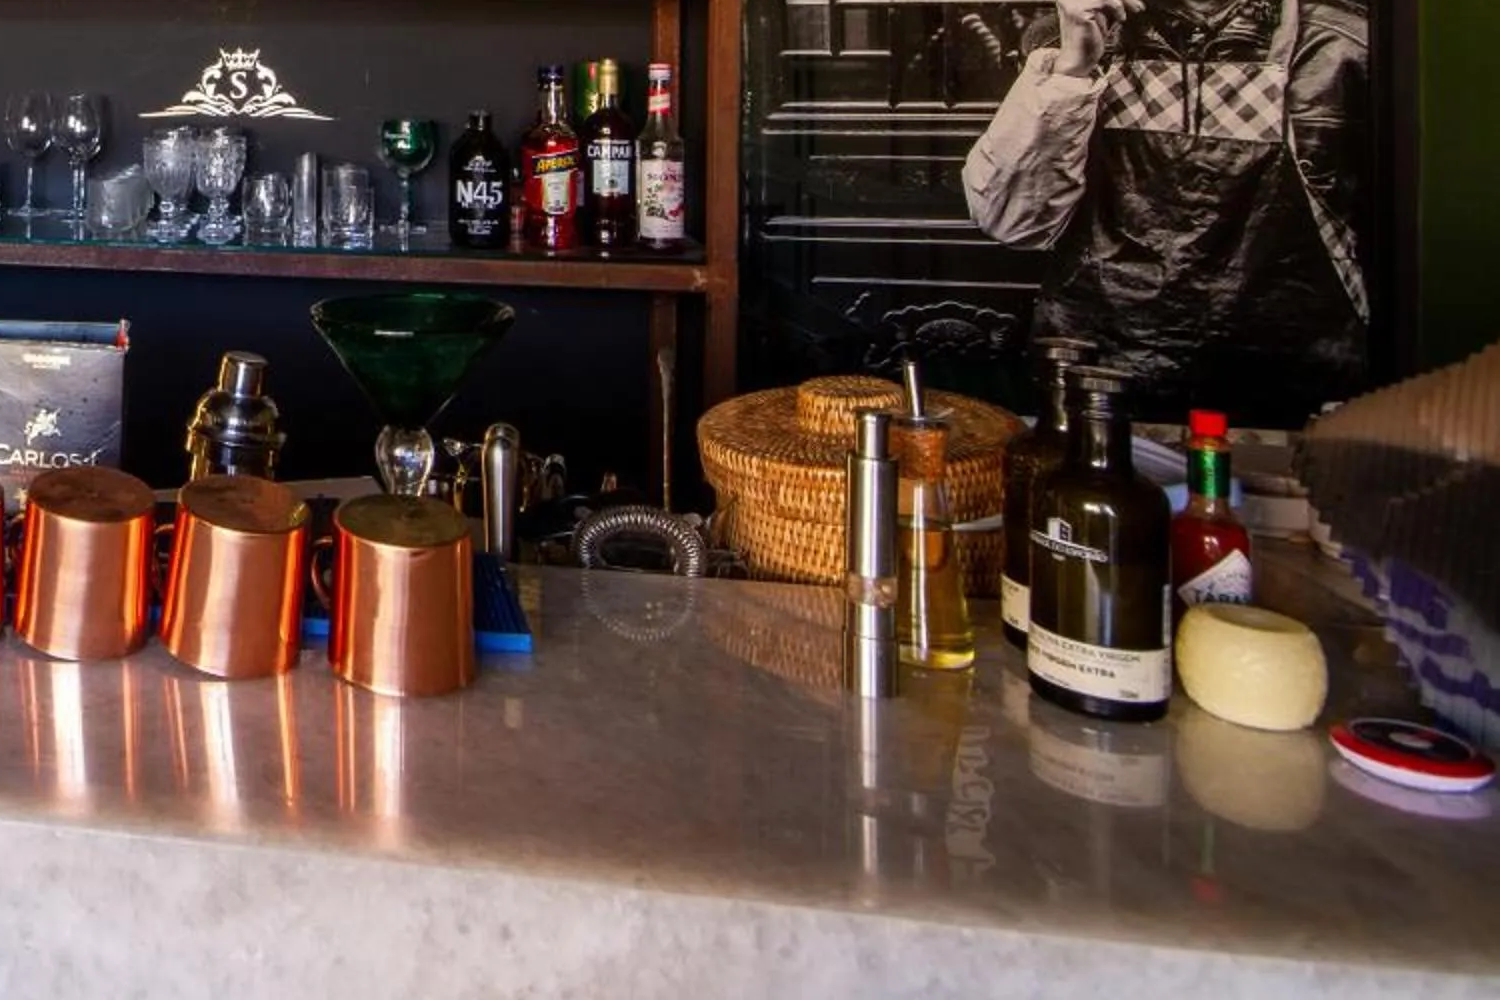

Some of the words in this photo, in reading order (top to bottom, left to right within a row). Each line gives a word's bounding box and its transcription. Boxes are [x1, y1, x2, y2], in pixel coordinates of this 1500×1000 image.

[230, 73, 247, 97] S
[535, 156, 576, 173] APEROL
[456, 180, 503, 205] N45
